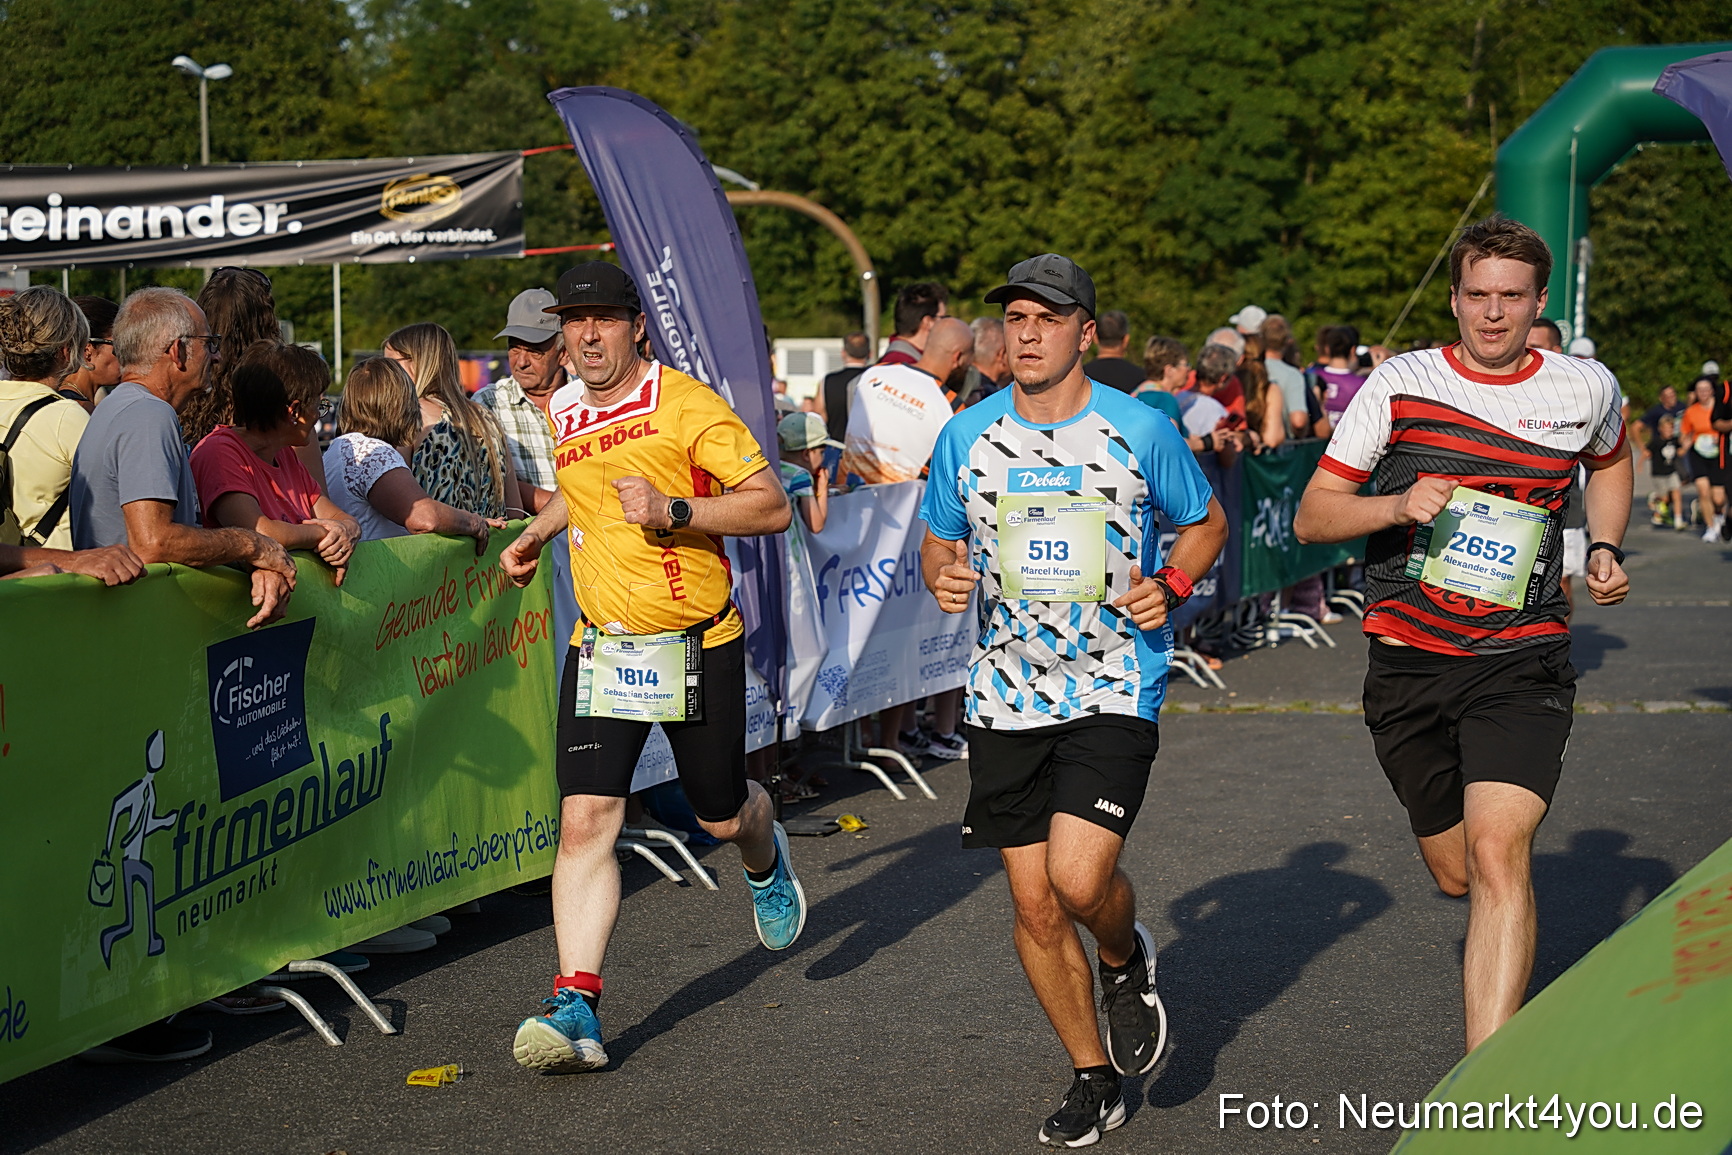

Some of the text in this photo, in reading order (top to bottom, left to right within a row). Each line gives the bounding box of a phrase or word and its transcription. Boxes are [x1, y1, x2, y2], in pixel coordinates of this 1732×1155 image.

[0, 192, 303, 242] einander.
[351, 227, 498, 245] Ein Ort, der verbindet.
[556, 419, 659, 473] MAX BÖGL
[1018, 470, 1071, 488] Debeka
[1028, 539, 1069, 561] 513
[1448, 531, 1517, 567] 2652
[1020, 565, 1081, 577] Marcel Krupa
[1443, 554, 1489, 575] Alexander
[1490, 567, 1516, 582] Seger
[1527, 576, 1539, 606] HILTL
[375, 566, 460, 651] Gesunde
[412, 631, 479, 699] laufen
[615, 666, 660, 687] 1814
[229, 672, 291, 715] Fischer
[603, 687, 675, 700] Sebastian Scherer
[236, 698, 287, 729] AUTOMOBILE
[264, 729, 277, 746] das
[567, 743, 594, 753] CRAFT
[172, 711, 393, 897] firmenlauf
[1093, 797, 1125, 818] JAKO
[176, 857, 279, 937] neumarkt
